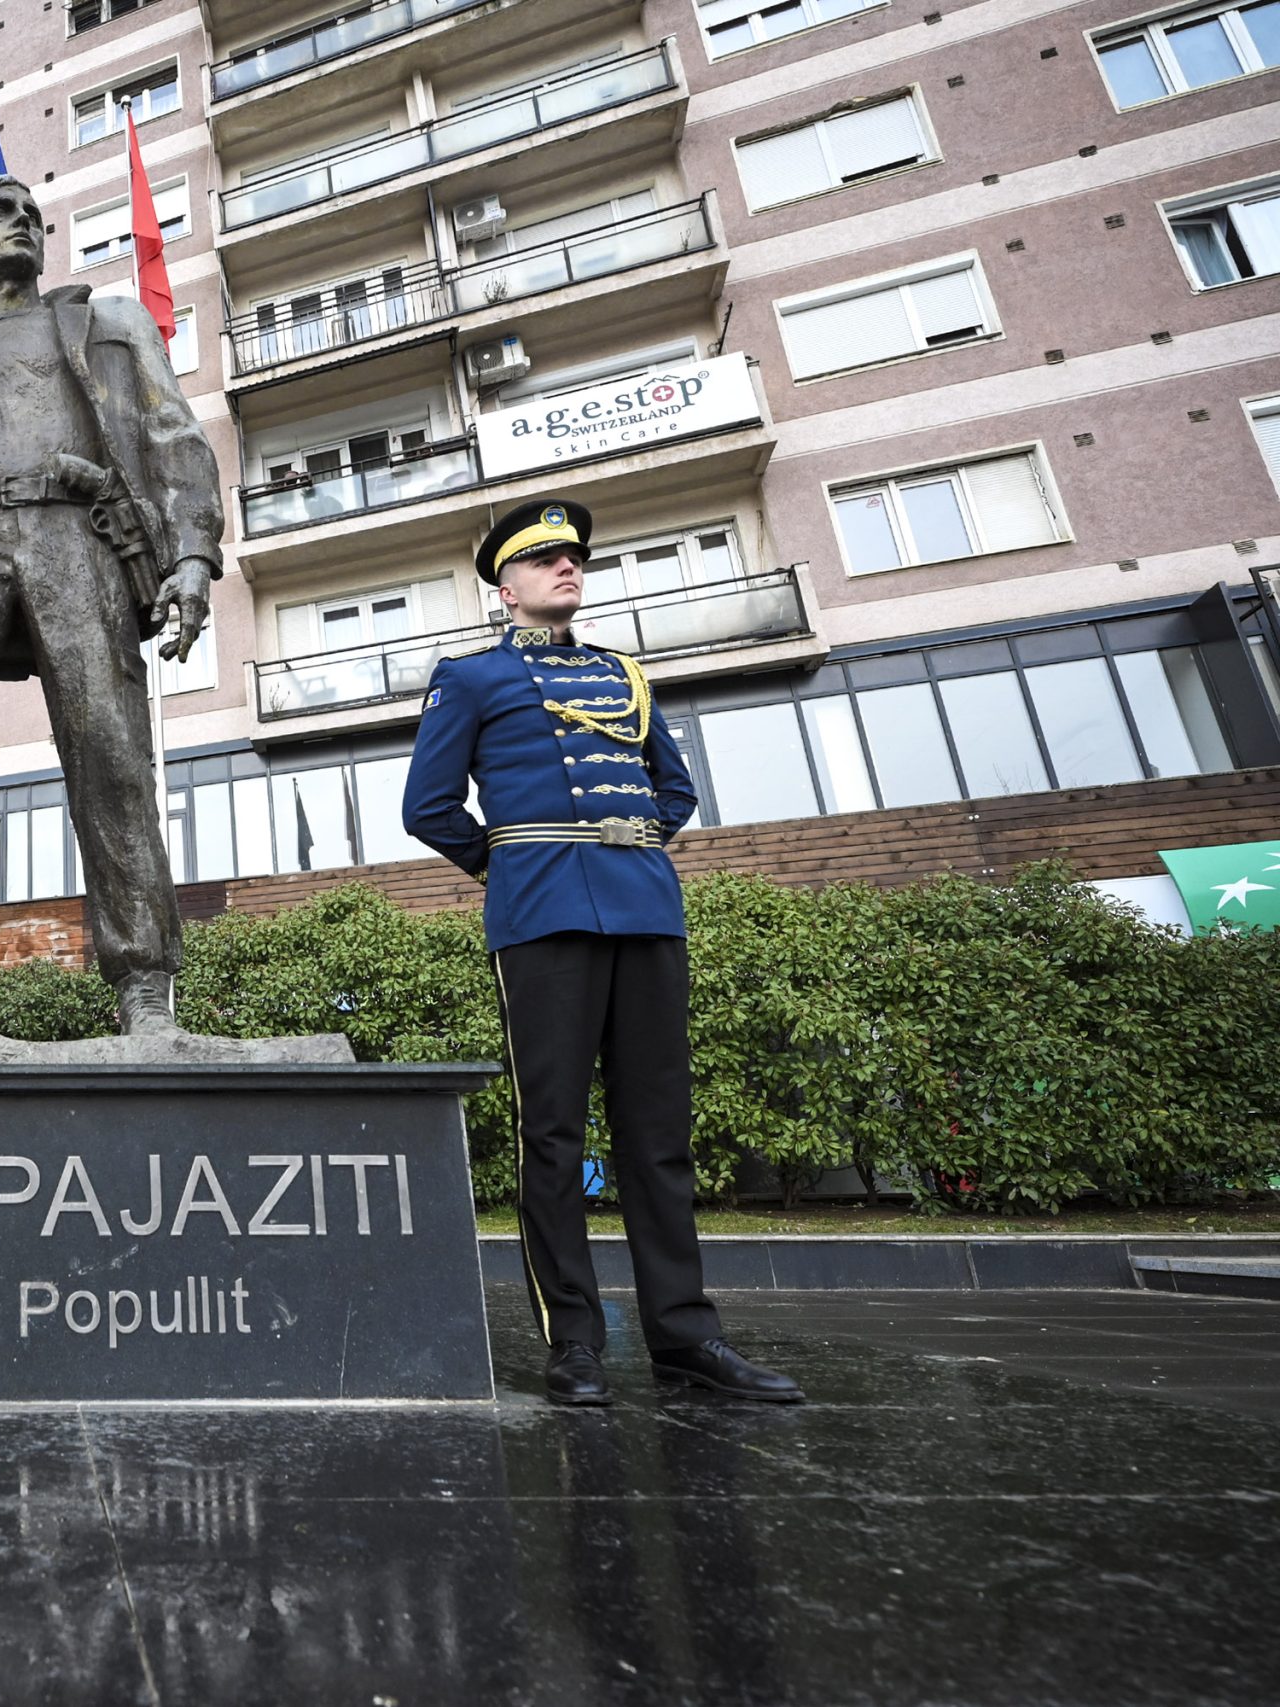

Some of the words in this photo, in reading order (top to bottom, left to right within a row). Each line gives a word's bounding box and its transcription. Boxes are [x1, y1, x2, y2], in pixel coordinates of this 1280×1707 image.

[571, 404, 681, 438] SWITZERLAND
[554, 439, 608, 457] Skin
[621, 422, 677, 442] Care
[18, 1275, 251, 1350] Popullit
